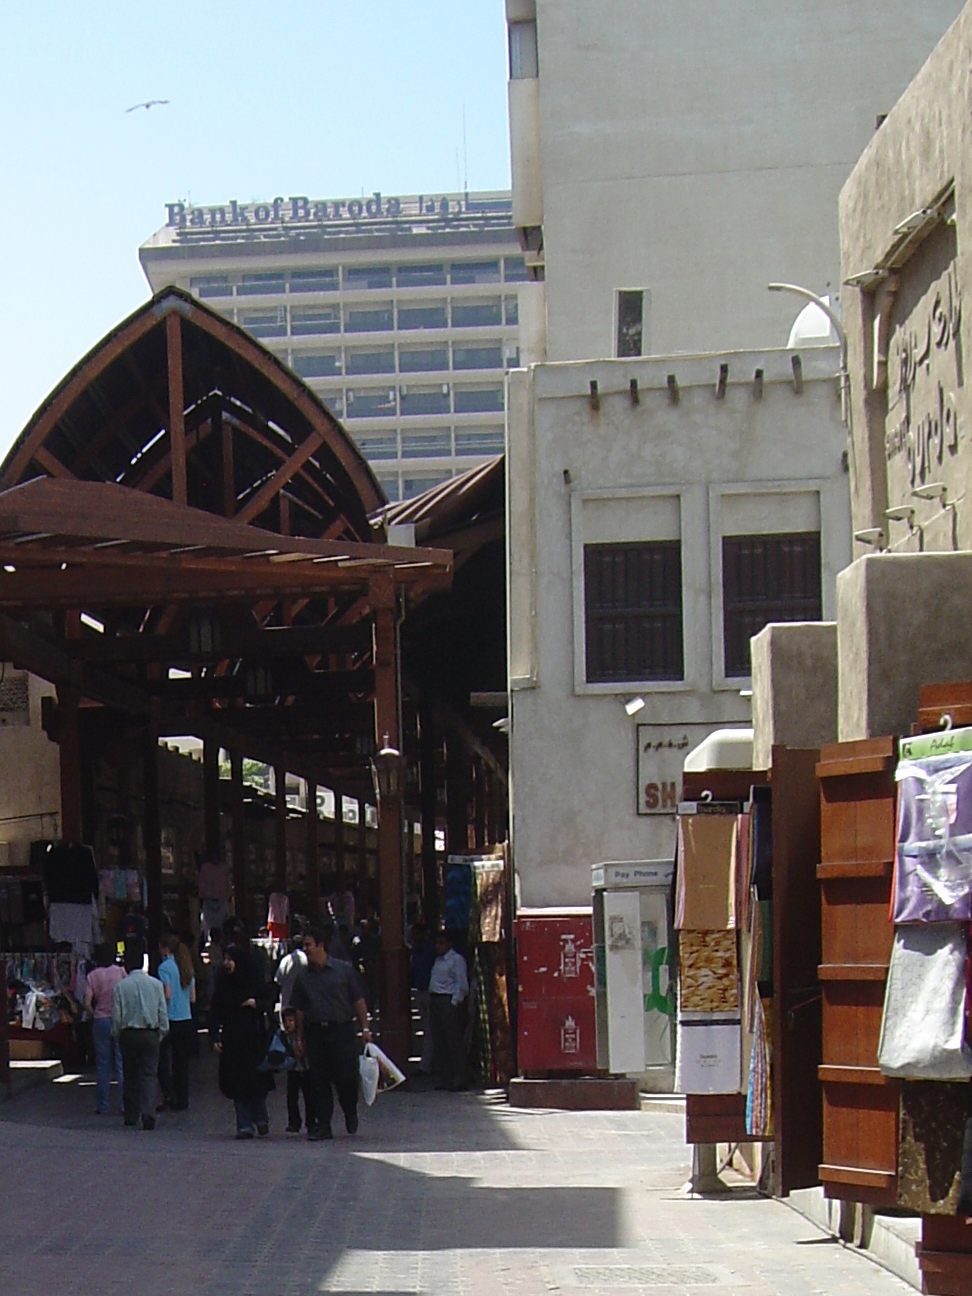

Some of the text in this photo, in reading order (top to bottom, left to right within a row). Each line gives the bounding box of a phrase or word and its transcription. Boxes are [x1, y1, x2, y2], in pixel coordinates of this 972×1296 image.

[164, 192, 405, 228] Bank of Baroda
[645, 782, 676, 809] SH
